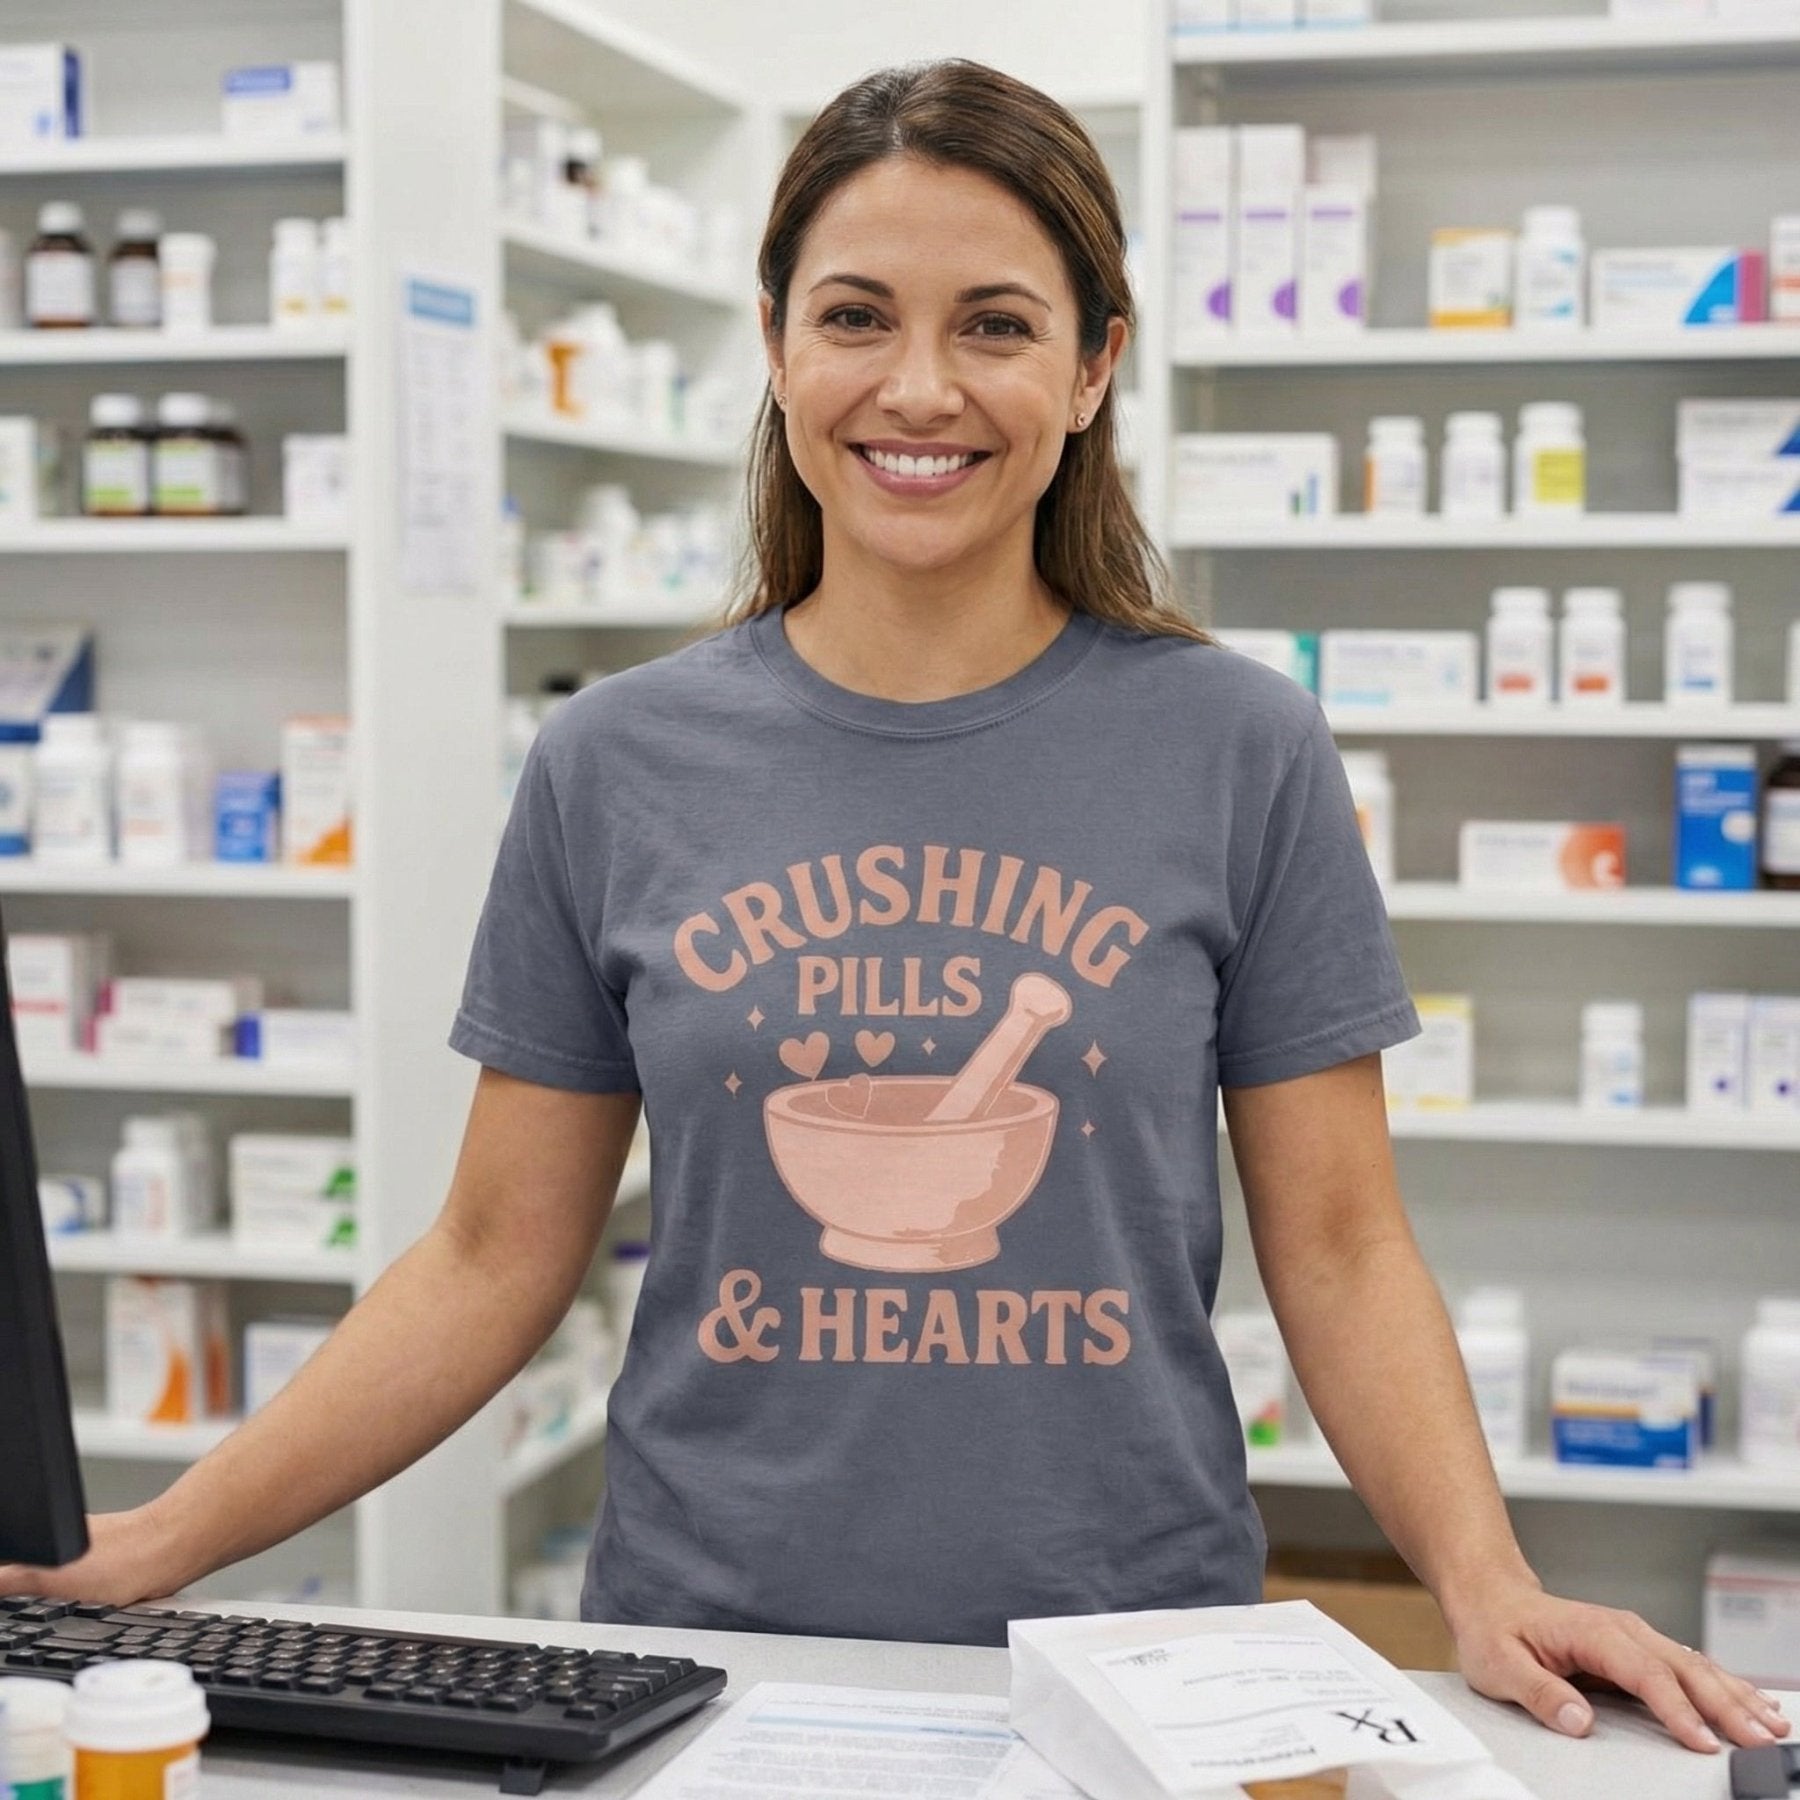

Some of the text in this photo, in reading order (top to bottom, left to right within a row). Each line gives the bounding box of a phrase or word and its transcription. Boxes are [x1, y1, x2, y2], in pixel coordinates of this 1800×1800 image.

[673, 844, 1150, 992] CRUSHING
[797, 955, 983, 1017] PILLS
[697, 1268, 1132, 1366] & HEARTS
